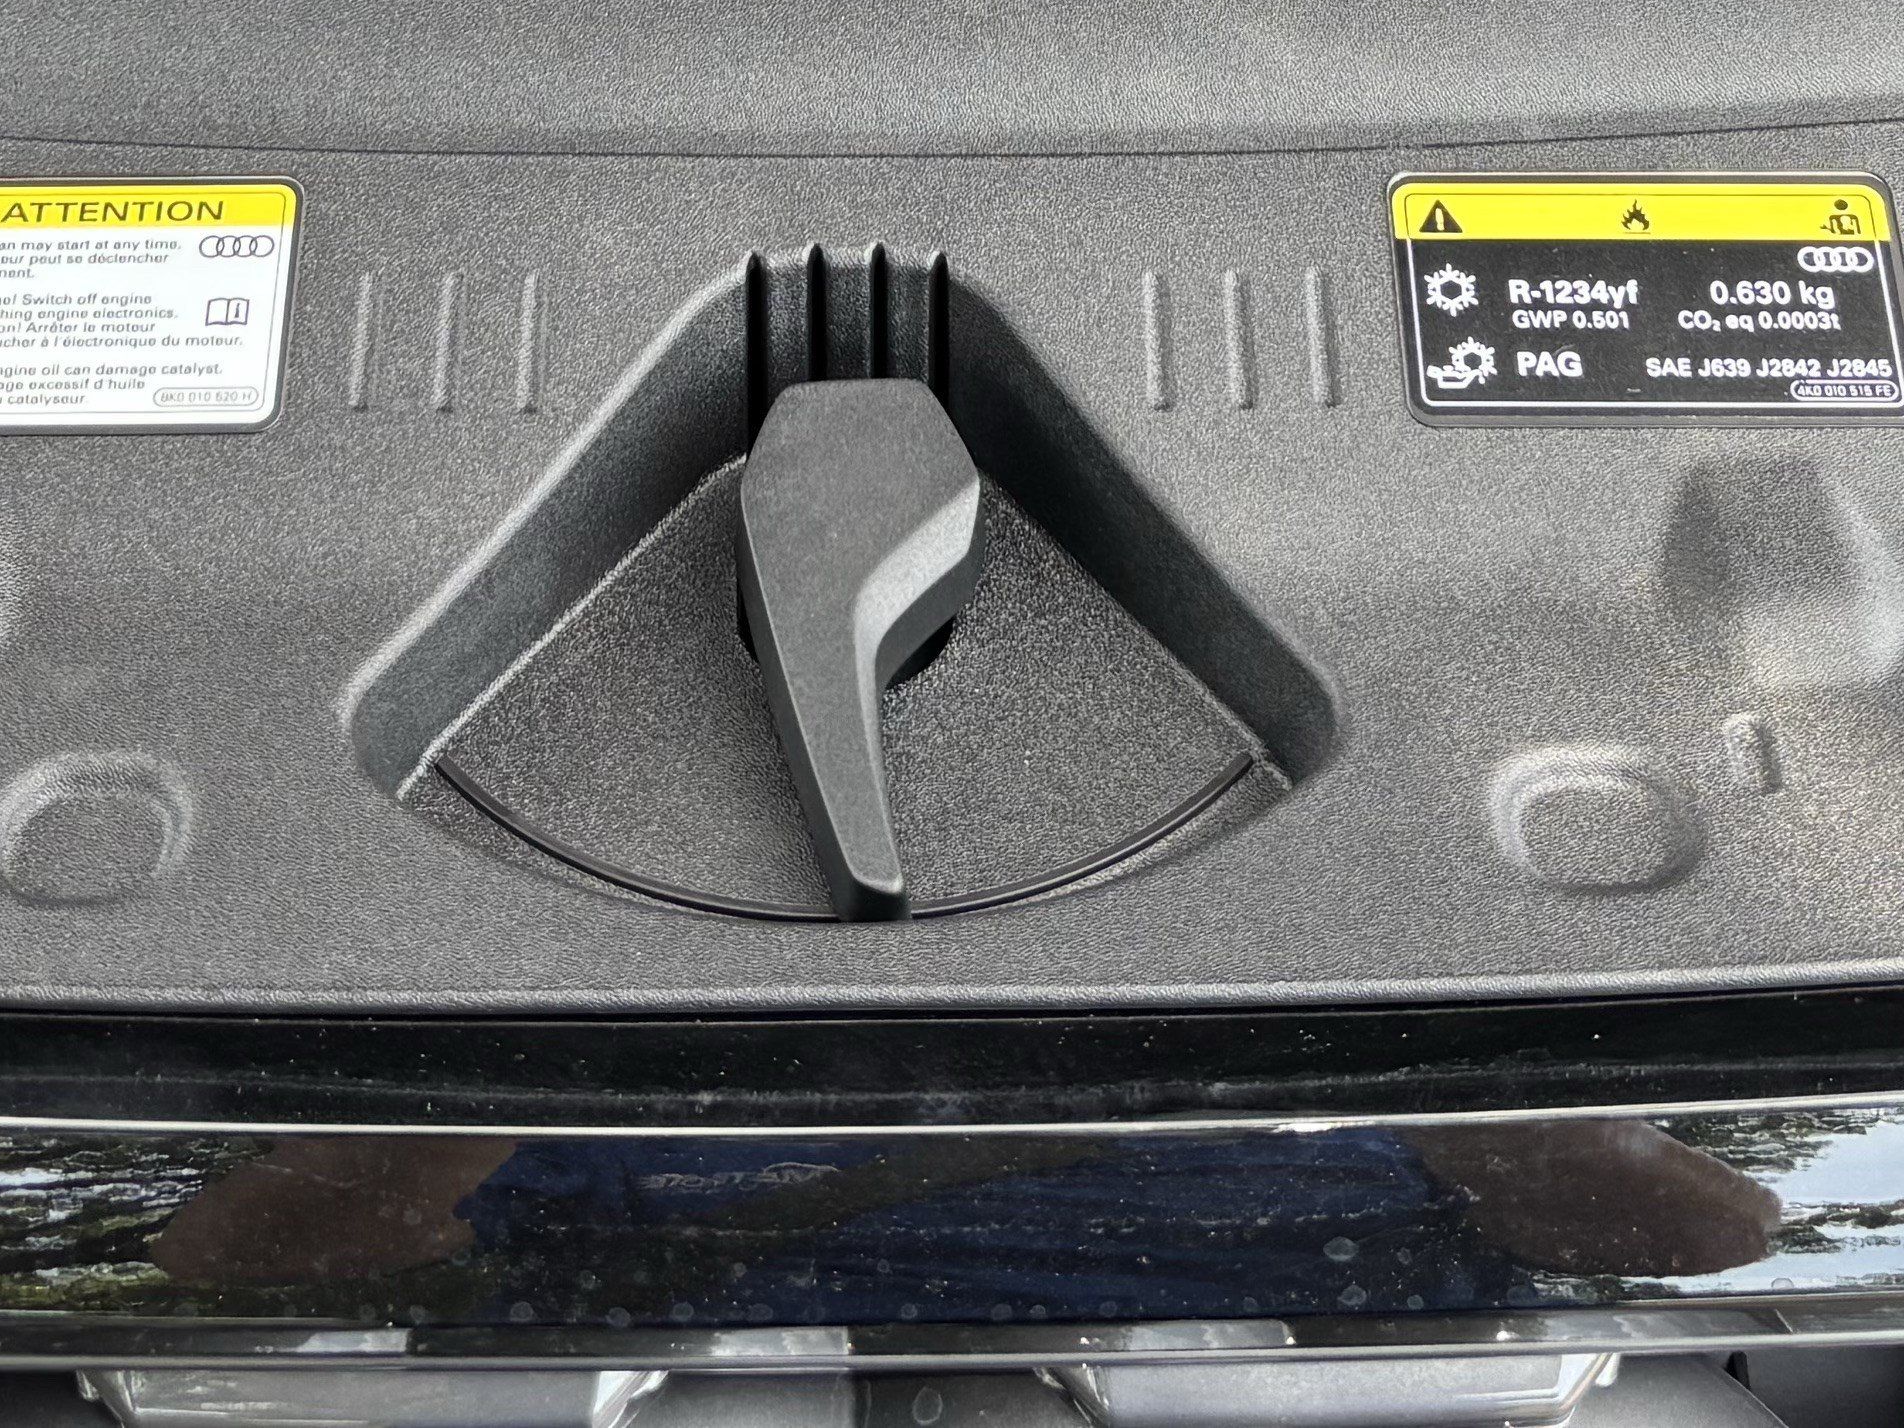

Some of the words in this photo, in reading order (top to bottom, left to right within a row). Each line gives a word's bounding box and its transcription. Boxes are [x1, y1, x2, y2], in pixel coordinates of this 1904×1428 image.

[1, 201, 223, 222] ATTENTION
[21, 242, 52, 252] may
[58, 241, 89, 250] start
[95, 241, 108, 249] at
[114, 242, 140, 251] any
[145, 240, 181, 249] time.
[29, 255, 61, 266] peut
[67, 256, 82, 264] se
[88, 253, 169, 264] déclencher
[22, 294, 72, 305] Switch
[77, 293, 97, 305] off
[101, 296, 151, 307] engine
[1508, 279, 1638, 309] R-1234yf
[1710, 280, 1792, 305] 0.630
[1798, 280, 1835, 310] kg
[38, 310, 88, 322] engine
[93, 307, 177, 318] electronics.
[1512, 310, 1567, 328] GWP
[1572, 310, 1629, 329] 0.501
[1725, 315, 1754, 332] eq
[1758, 311, 1841, 330] 0.0003t
[26, 321, 77, 333] Arrêter
[83, 322, 95, 332] le
[101, 323, 155, 332] moteur
[162, 335, 180, 346] du
[185, 336, 242, 346] moteur.
[42, 364, 59, 375] oil
[64, 367, 90, 375] can
[96, 364, 156, 377] damage
[161, 363, 222, 376] catalyst.
[1517, 351, 1583, 377] PAG
[1646, 357, 1692, 378] SAE
[1698, 358, 1751, 377] J639
[1756, 358, 1821, 377] J2842
[1827, 359, 1892, 377] J2845
[29, 378, 89, 390] excessif
[1798, 385, 1822, 396] 4K0
[1824, 385, 1846, 396] 010
[1876, 386, 1892, 397] FE
[189, 392, 211, 403] 010
